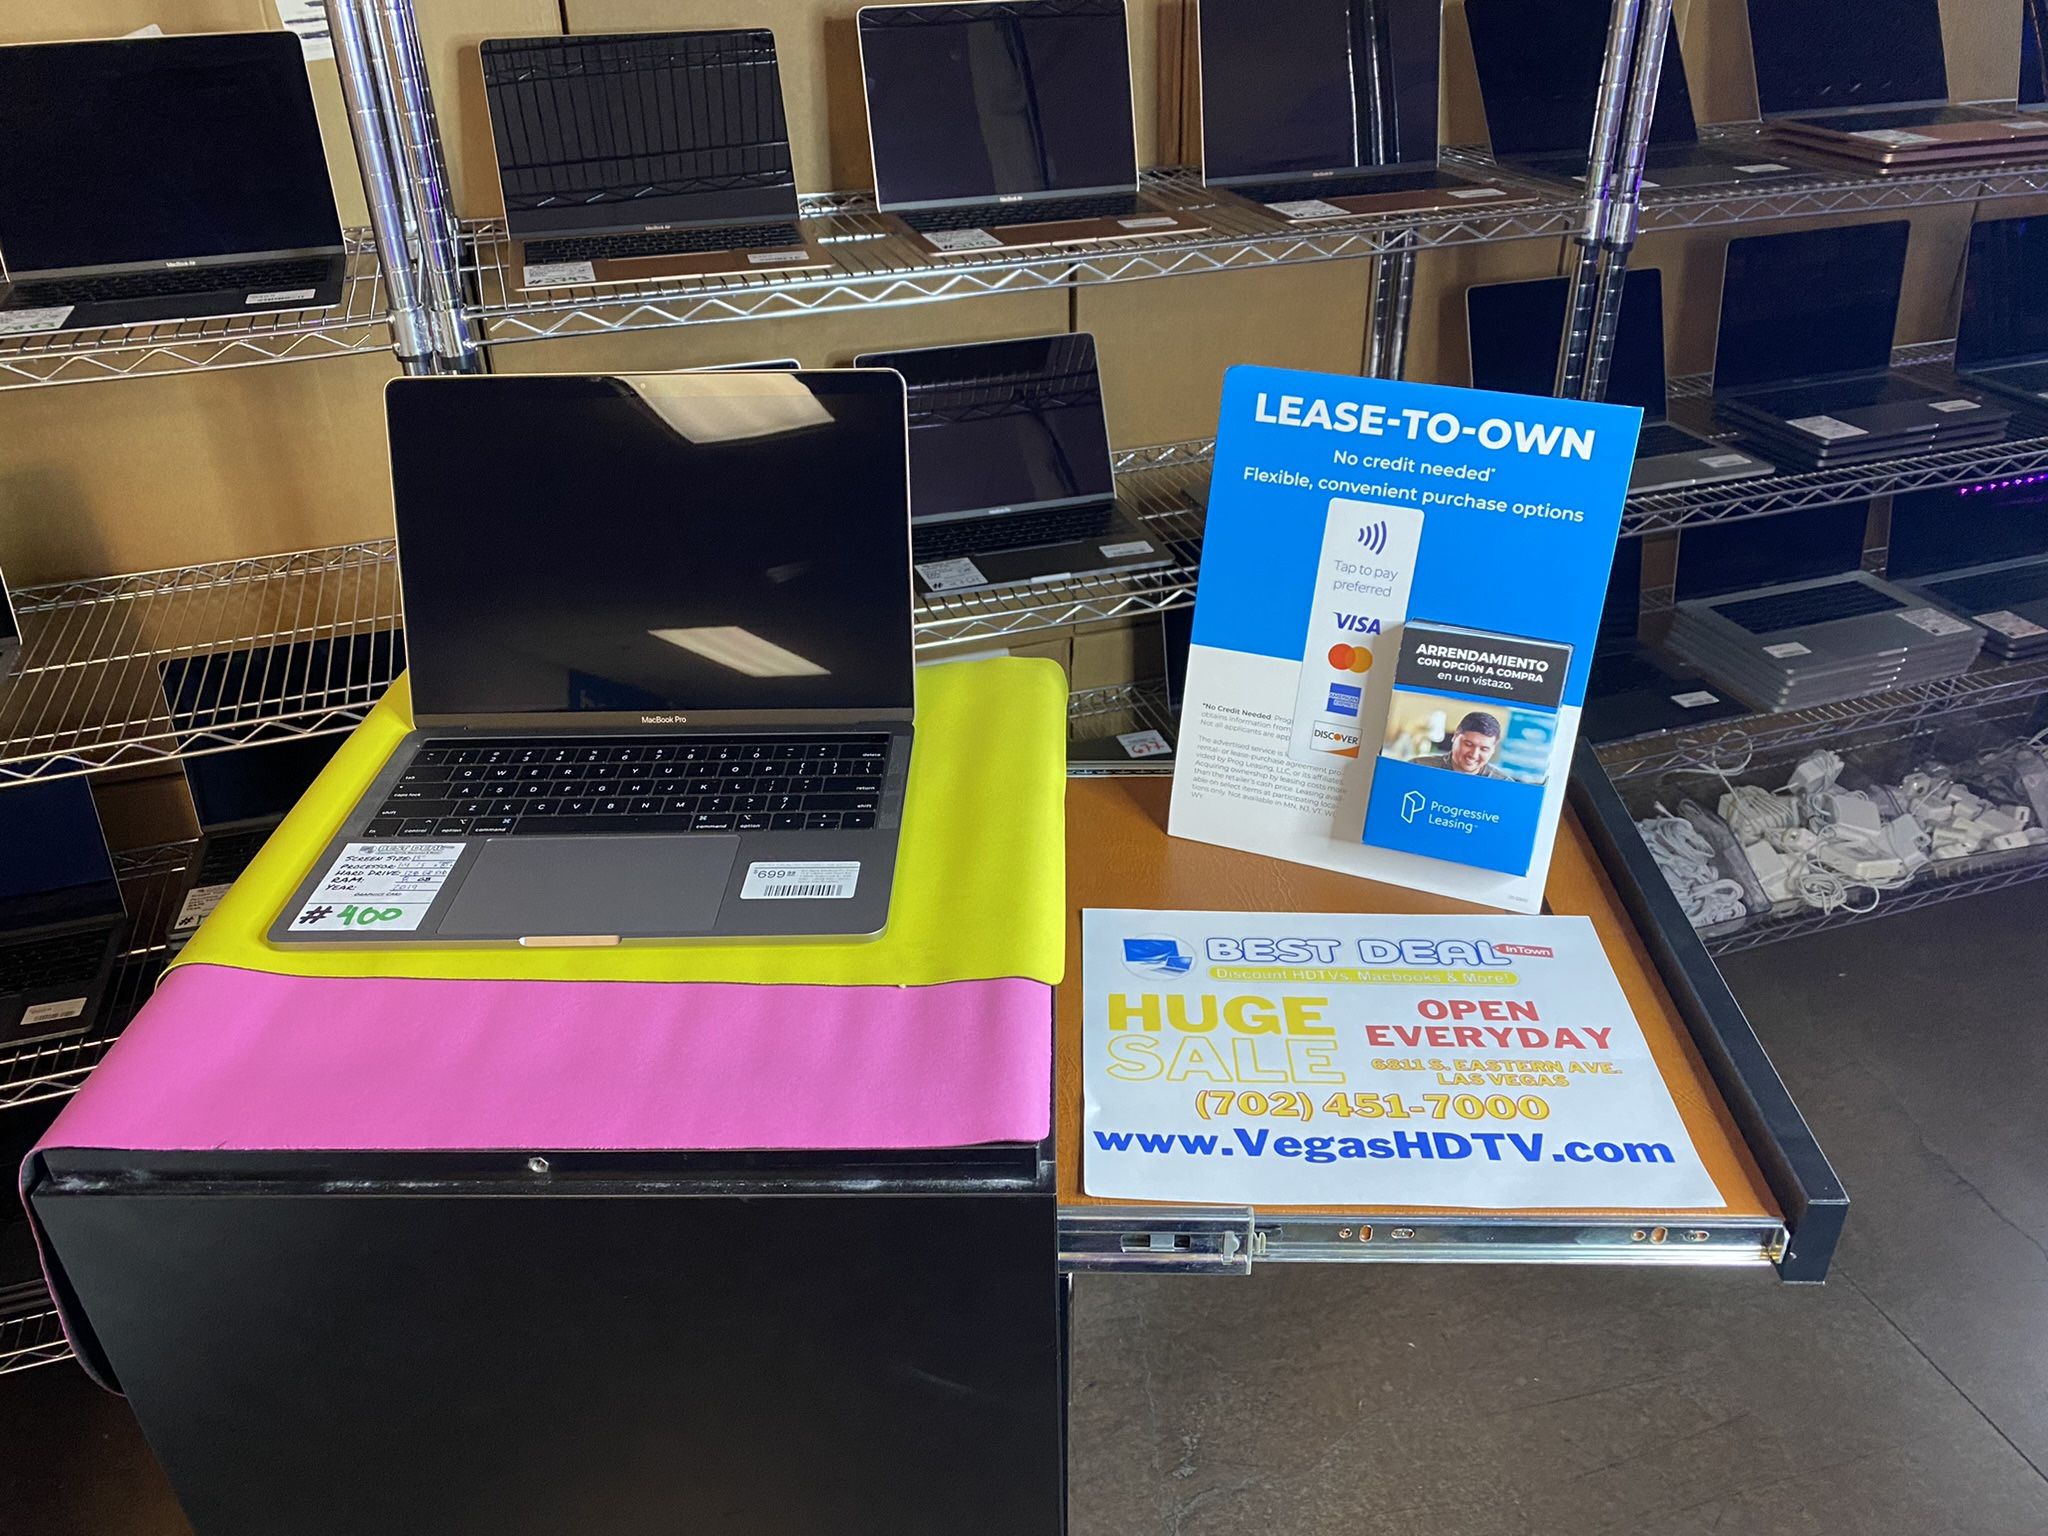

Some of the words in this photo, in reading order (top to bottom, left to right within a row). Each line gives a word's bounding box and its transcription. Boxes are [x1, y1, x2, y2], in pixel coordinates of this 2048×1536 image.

[1255, 392, 1596, 460] LEASE-TO-OWN
[1334, 450, 1358, 465] No
[1363, 456, 1415, 473] credit
[1244, 466, 1314, 490] Flexible,
[1318, 478, 1418, 501] convenient
[1422, 491, 1508, 512] purchase
[1512, 503, 1584, 522] options
[1334, 560, 1357, 574] Tap
[1360, 564, 1372, 576] to
[1375, 568, 1398, 582] pay
[1333, 580, 1392, 598] preferred
[1333, 612, 1380, 635] VISA
[1416, 644, 1549, 672] ARRENDAMIENTO
[1417, 657, 1440, 668] CON
[1442, 660, 1484, 674] OPCIÓN
[1486, 666, 1494, 676] A
[1496, 668, 1544, 683] COMPRA
[1437, 672, 1452, 681] en
[1454, 674, 1470, 684] un
[1472, 676, 1514, 690] vistazo.
[1217, 705, 1240, 715] Credit
[1229, 716, 1272, 728] information
[1314, 729, 1358, 744] DISCOVER
[1286, 760, 1327, 774] agreement
[1430, 800, 1500, 823] Progressive
[1206, 937, 1342, 964] BEST
[1357, 938, 1512, 966] DEAL
[1216, 968, 1287, 979] Discount
[1358, 972, 1440, 984] Macbooks
[1446, 972, 1458, 984] &
[1463, 973, 1510, 984] More!
[1108, 993, 1336, 1036] HUGE
[1417, 998, 1540, 1021] OPEN
[1365, 1024, 1612, 1050] EVERYDAY
[1106, 1034, 1346, 1084] SALE
[1371, 1058, 1426, 1072] 6811
[1428, 1058, 1450, 1072] S.
[1454, 1058, 1564, 1073] EASTERN
[1568, 1061, 1623, 1074] AVE.
[1436, 1072, 1485, 1086] LAS
[1487, 1072, 1570, 1087] VEGAS
[1194, 1090, 1313, 1122] (702)
[1322, 1092, 1550, 1120] 451-7000
[1093, 1128, 1676, 1164] www.VegasHDTV.com
